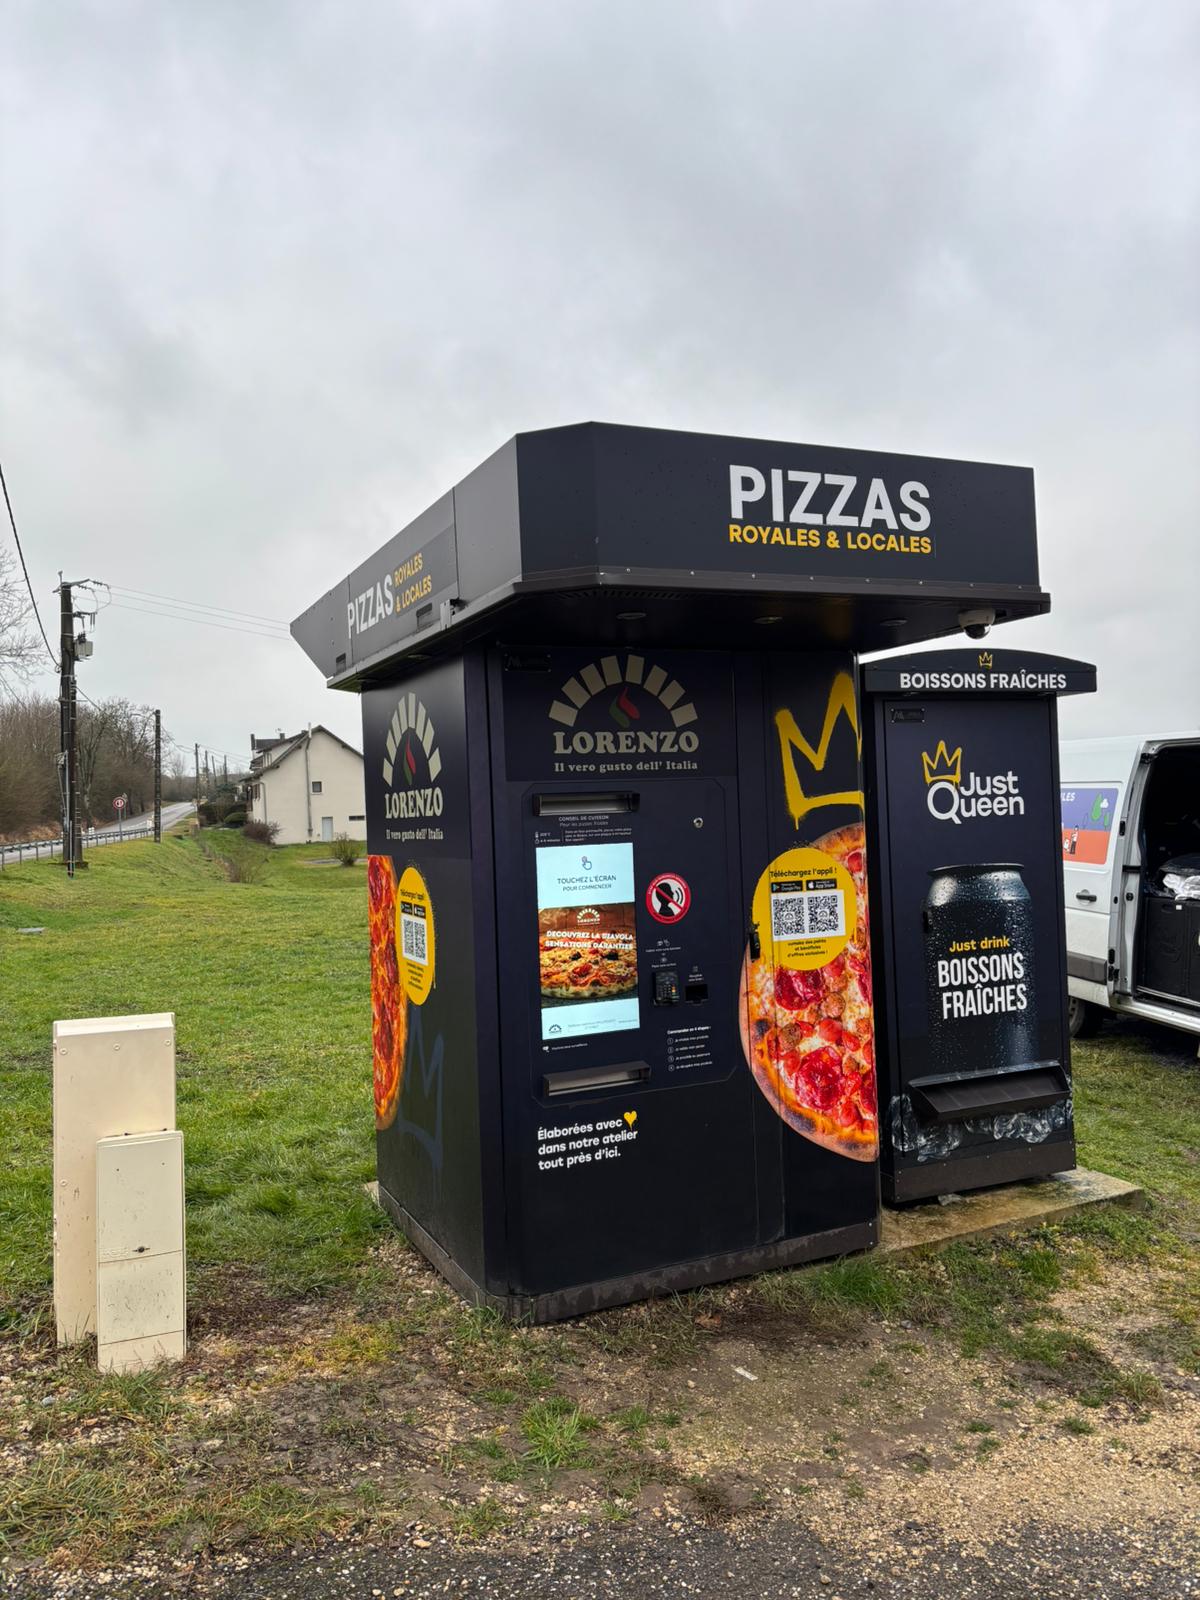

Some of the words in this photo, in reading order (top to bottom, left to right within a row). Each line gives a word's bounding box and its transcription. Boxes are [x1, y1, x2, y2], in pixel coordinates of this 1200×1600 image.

[729, 464, 932, 532] PIZZAS
[728, 524, 821, 548] ROYALES
[825, 530, 840, 548] &
[847, 532, 932, 554] LOCALES
[394, 552, 423, 587] ROYALES
[402, 574, 432, 608] LOCALES
[347, 574, 394, 639] PIZZAS
[900, 672, 987, 689] BOISSONS
[990, 669, 1067, 689] FRAÎCHES
[553, 730, 700, 754] LORENZO
[554, 762, 565, 772] Il
[568, 763, 596, 772] vero
[600, 762, 633, 774] gusto
[636, 761, 662, 771] dell'
[666, 760, 698, 771] Italia
[960, 771, 1019, 796] Just
[384, 786, 444, 819] LORENZO
[927, 781, 1025, 824] Queen
[557, 876, 588, 884] TOUCHEZ
[769, 869, 812, 879] Téléchargez
[949, 939, 977, 952] Just
[980, 935, 1010, 949] drink
[937, 952, 1025, 987] BOISSONS
[942, 983, 1028, 1020] FRAÎCHES
[537, 1123, 594, 1141] Élaborées
[596, 1119, 623, 1131] avec
[538, 1143, 567, 1156] dans
[569, 1136, 600, 1151] notre
[602, 1129, 638, 1144] atelier
[538, 1157, 564, 1170] tout
[566, 1152, 592, 1169] près
[595, 1146, 621, 1160] d'ici.
